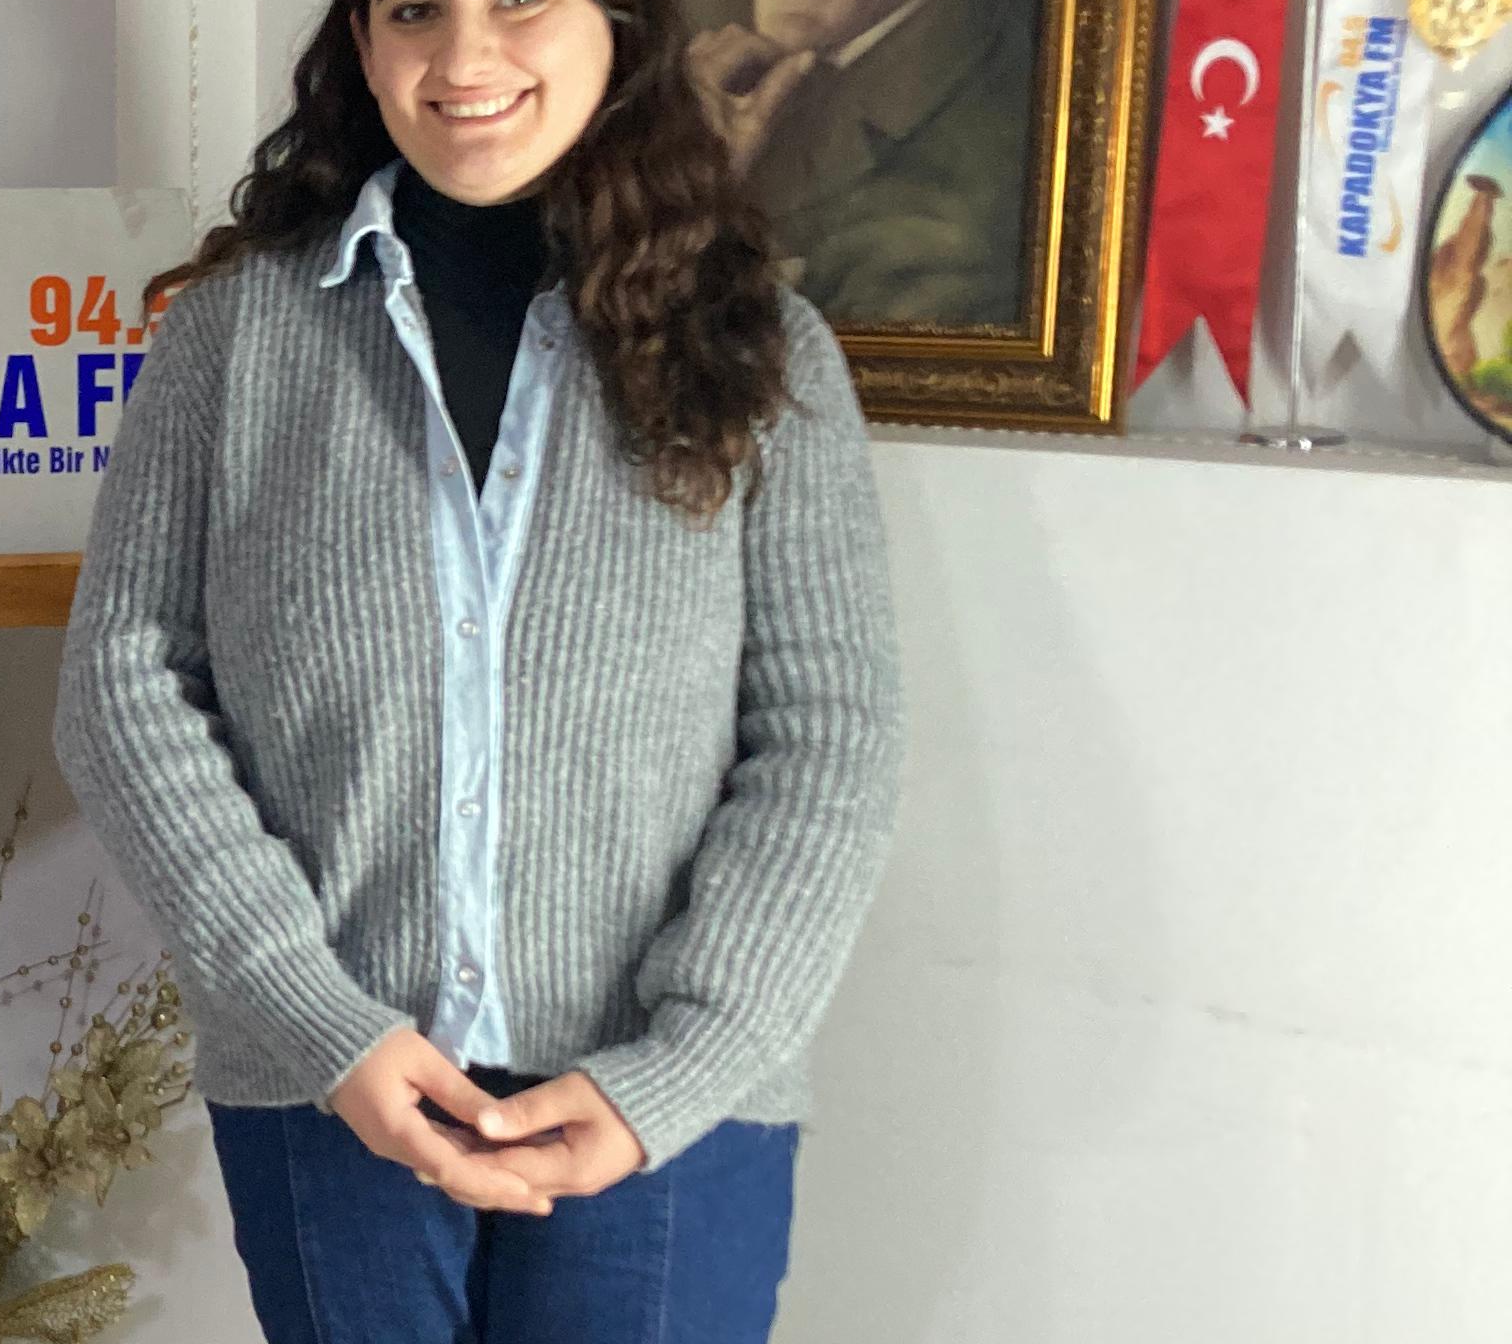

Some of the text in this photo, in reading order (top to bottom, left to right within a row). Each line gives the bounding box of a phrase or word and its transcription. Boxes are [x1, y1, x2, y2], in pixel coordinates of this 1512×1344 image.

[1363, 17, 1396, 61] FM
[1339, 71, 1388, 257] KAPADOKYA
[49, 446, 85, 474] Bir
